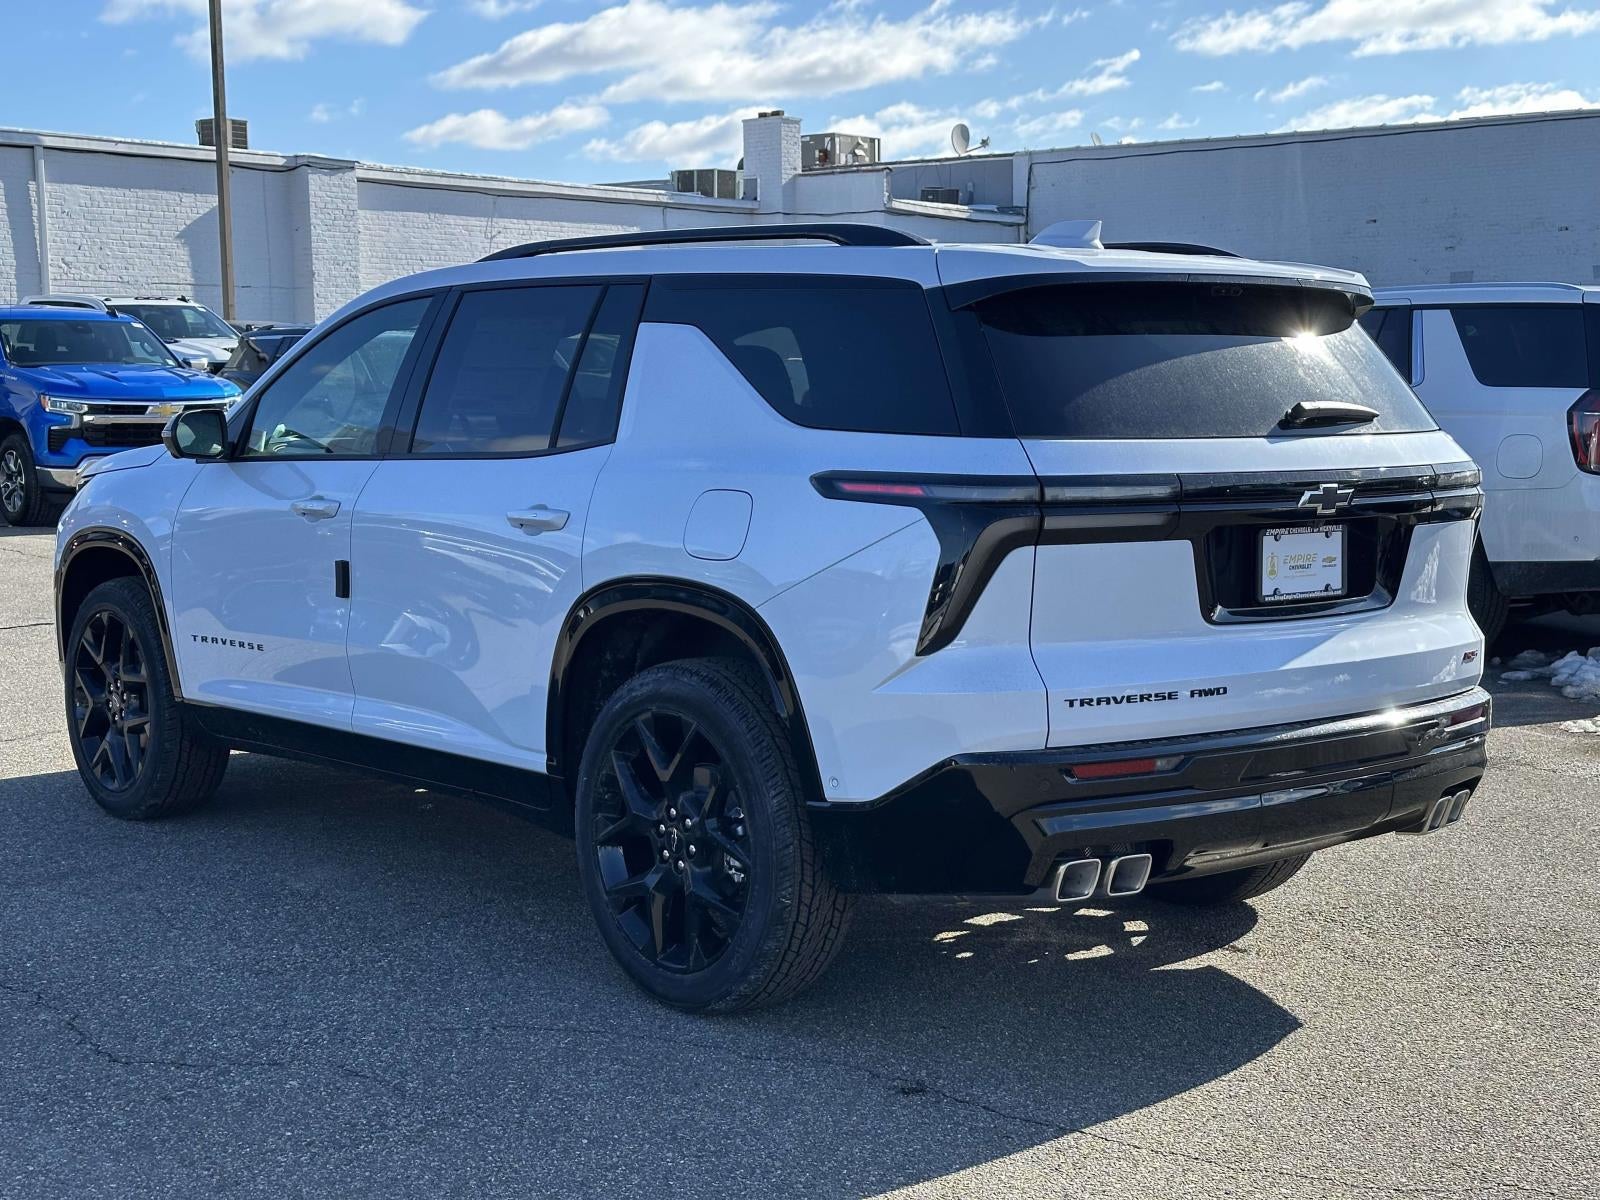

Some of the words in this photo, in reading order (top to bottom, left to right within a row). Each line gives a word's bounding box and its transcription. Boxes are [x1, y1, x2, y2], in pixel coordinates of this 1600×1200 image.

[1283, 552, 1318, 564] EMPIRE
[191, 634, 264, 651] TRAVERSE
[1064, 690, 1179, 708] TRAVERSE
[1189, 686, 1228, 698] AWD
